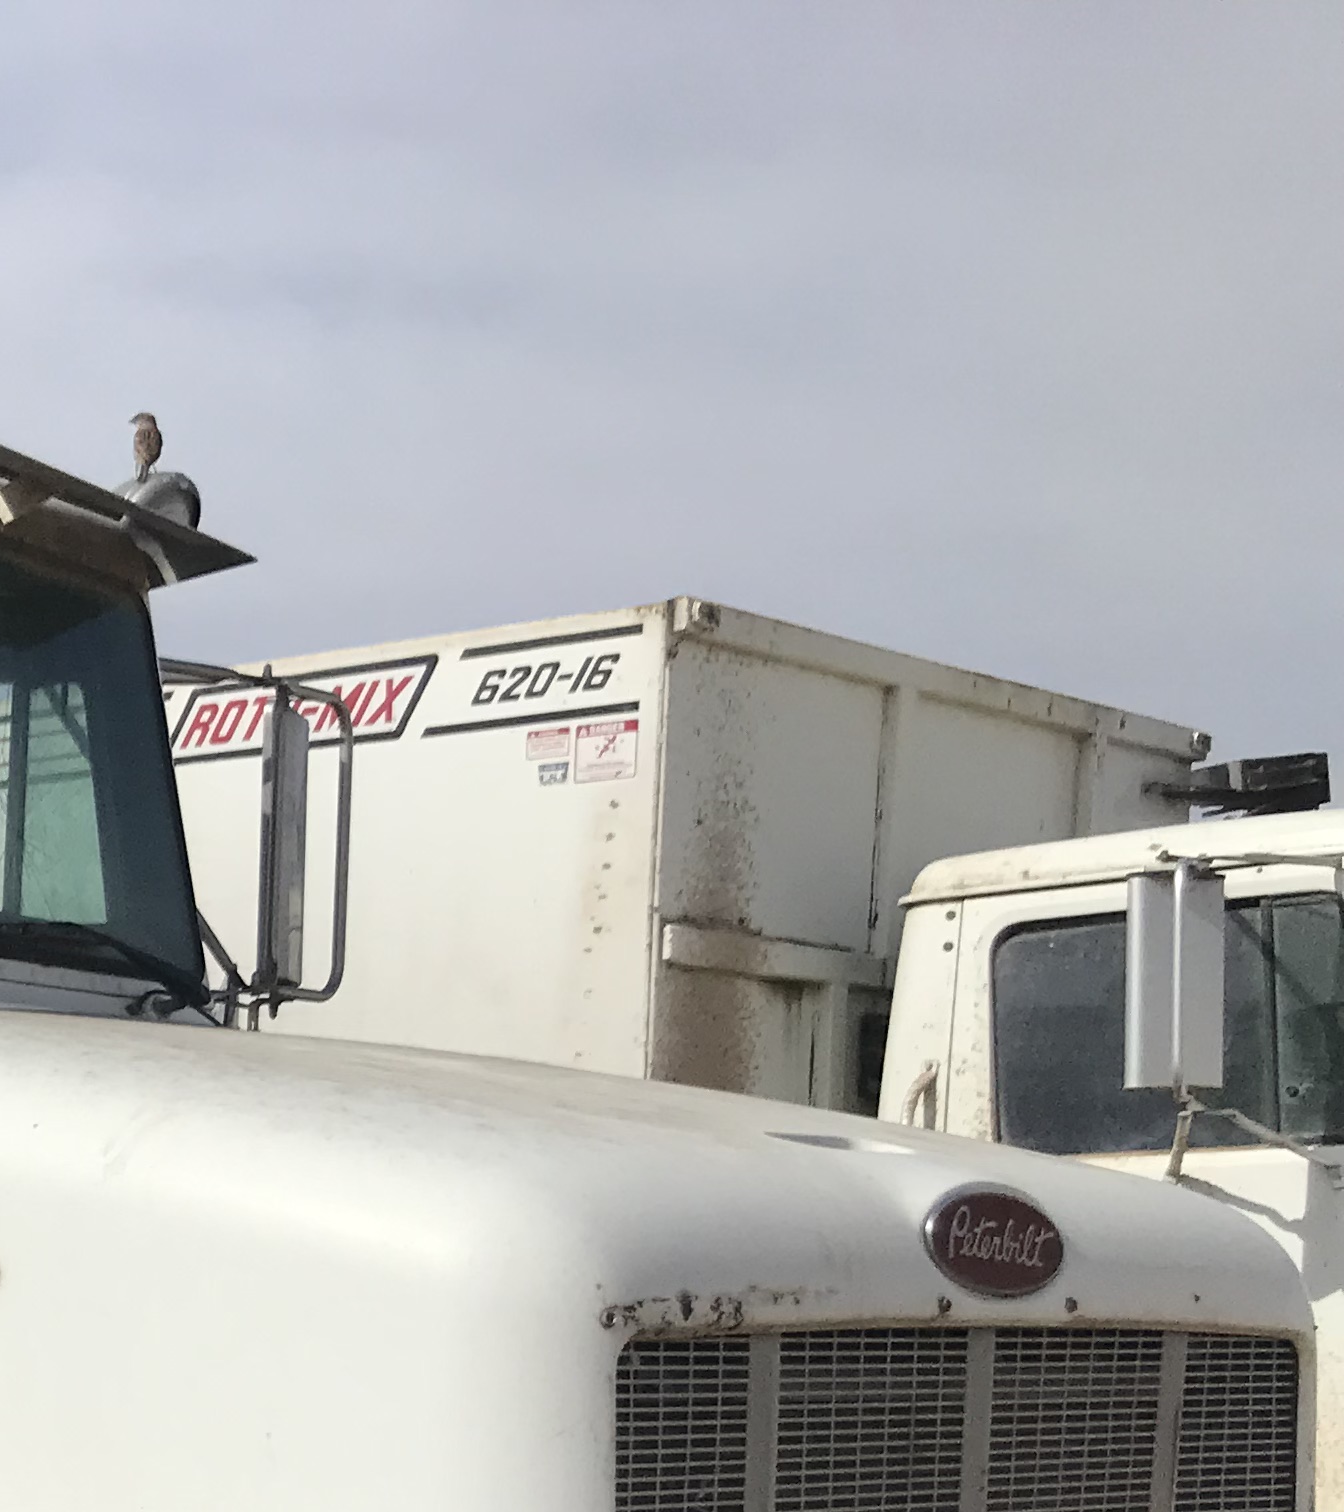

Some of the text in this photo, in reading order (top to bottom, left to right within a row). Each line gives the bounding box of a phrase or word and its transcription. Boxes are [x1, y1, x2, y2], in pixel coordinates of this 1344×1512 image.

[470, 653, 621, 706] 620-16
[179, 675, 414, 751] ROT-MIX
[948, 1204, 1054, 1267] Peterbilt
